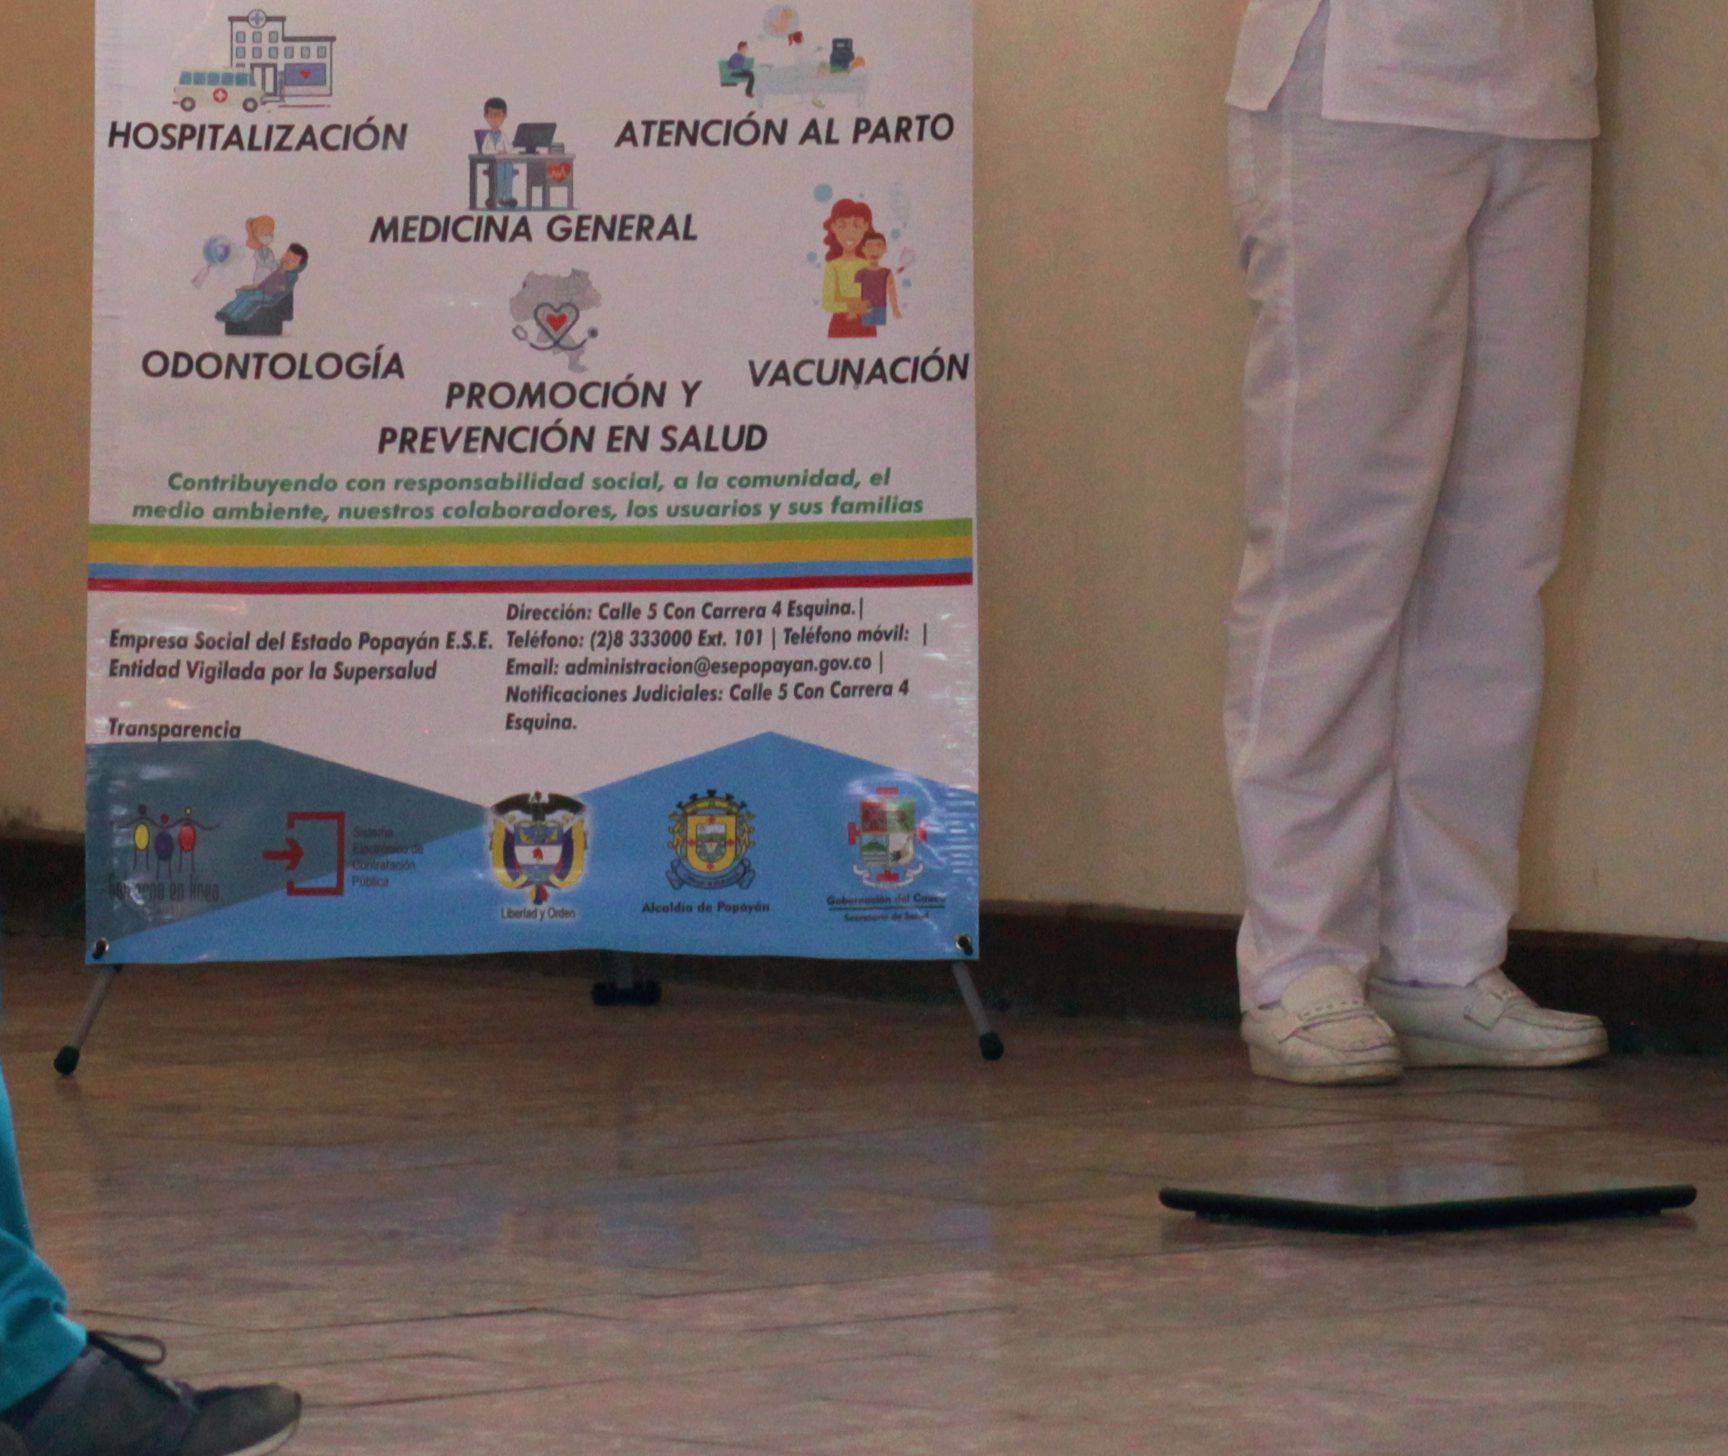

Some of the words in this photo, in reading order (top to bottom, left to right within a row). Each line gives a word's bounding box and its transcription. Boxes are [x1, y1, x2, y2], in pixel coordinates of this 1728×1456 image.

[107, 115, 408, 152] HOSPITALIZACIÓN
[614, 110, 789, 148] ATENCIÓN
[798, 117, 840, 146] AL
[852, 112, 955, 145] PARTO
[369, 214, 533, 244] MEDICINA
[546, 213, 698, 243] GENERAL
[141, 343, 405, 381] ODONTOLOGÍA
[748, 346, 970, 388] VACUNACIÓN
[445, 373, 666, 410] PROMOCIÓN
[681, 380, 702, 408] Y
[377, 417, 596, 455] PREVENCIÓN
[606, 425, 650, 453] EN
[660, 423, 768, 453] SALUD
[167, 471, 339, 498] Contribuyendo
[345, 477, 386, 492] con
[393, 471, 585, 496] responsabilidad
[591, 470, 665, 493] social,
[673, 475, 689, 490] a
[696, 470, 719, 490] la
[726, 467, 861, 490] comunidad,
[869, 466, 892, 487] el
[132, 499, 205, 520] medio
[212, 500, 330, 523] ambiente,
[337, 503, 435, 520] nuestros
[441, 499, 618, 522] colaboradores,
[626, 498, 659, 519] los
[666, 498, 762, 518] usuarios
[769, 502, 782, 522] y
[788, 501, 823, 516] sus
[830, 494, 924, 515] familias
[506, 602, 592, 622] Dirección:
[598, 601, 642, 621] Calle
[646, 602, 658, 621] 5
[663, 601, 696, 621] Con
[701, 601, 767, 620] Carrera
[771, 600, 782, 618] 4
[108, 628, 189, 654] Empresa
[194, 630, 251, 651] Social
[255, 630, 286, 652] del
[290, 630, 353, 652] Estado
[357, 631, 440, 656] Popayán
[445, 630, 493, 650] E.S.E.
[506, 629, 585, 649] Teléfono:
[589, 629, 624, 652] (2)8
[629, 628, 693, 648] 333000
[697, 628, 727, 647] Ext.
[735, 628, 763, 647] 101
[783, 624, 853, 646] Teléfono
[856, 622, 910, 643] móvil:
[108, 657, 181, 679] Entidad
[186, 660, 266, 685] Vigilada
[270, 665, 304, 686] por
[308, 660, 328, 681] la
[332, 659, 438, 686] Supersalud
[505, 657, 559, 676] Email:
[565, 655, 872, 678] administracion@esepopayan.gov.co
[505, 683, 628, 704] Notificaciones
[631, 682, 724, 703] Judiciales:
[729, 682, 773, 702] Calle
[777, 682, 789, 701] 5
[793, 681, 825, 701] Con
[829, 680, 894, 700] Carrera
[898, 678, 910, 696] 4
[108, 718, 241, 742] Transparencia
[505, 712, 577, 735] Esquina.
